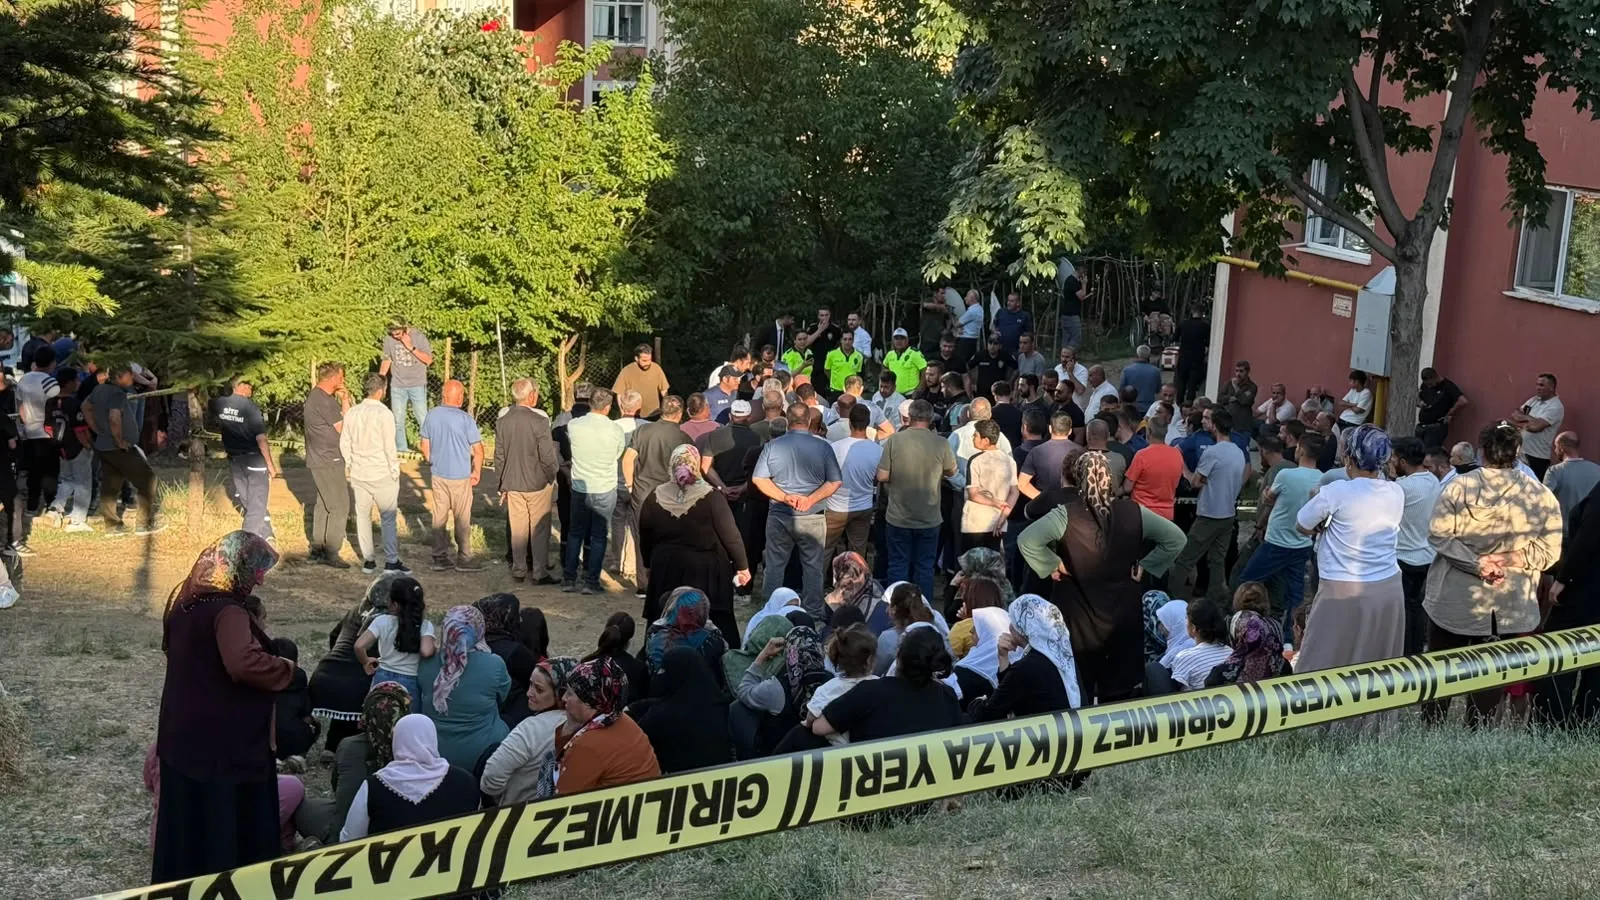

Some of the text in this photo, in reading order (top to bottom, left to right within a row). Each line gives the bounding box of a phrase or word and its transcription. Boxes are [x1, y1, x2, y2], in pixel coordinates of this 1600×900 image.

[1432, 640, 1540, 684] GİRİLMEZ
[1557, 627, 1600, 664] ERİ
[1272, 675, 1342, 726] YERİ
[1337, 661, 1417, 702] KAZA
[943, 723, 1050, 781] KAZA
[1088, 694, 1235, 754] GİRİLMEZ
[837, 744, 936, 812] YERİ
[527, 773, 769, 858] GİRİLMEZ
[270, 826, 462, 900] KAZA
